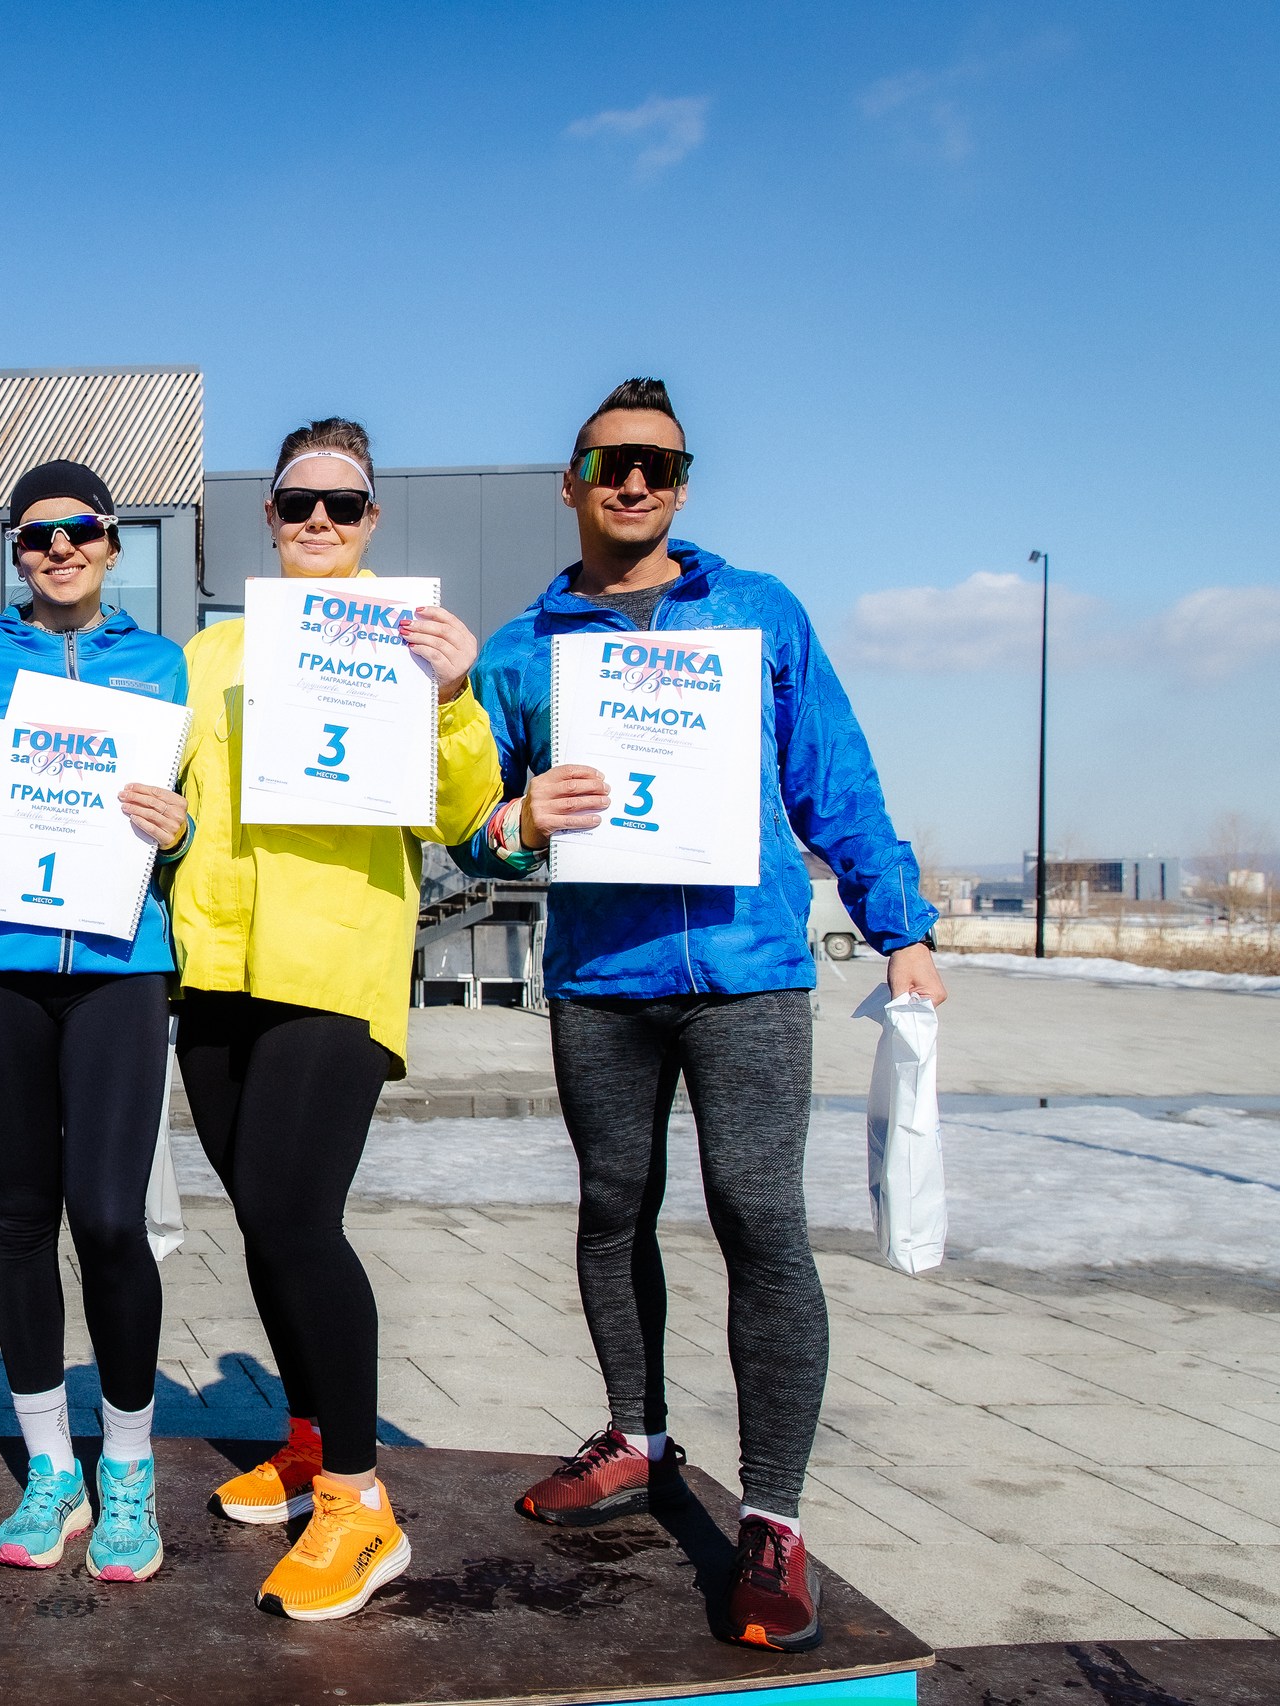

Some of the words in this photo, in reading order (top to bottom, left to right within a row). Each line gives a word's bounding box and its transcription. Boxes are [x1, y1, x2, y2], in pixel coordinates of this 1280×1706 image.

[303, 594, 414, 630] ГОНКА
[300, 621, 321, 633] за
[321, 620, 411, 648] Весно
[298, 652, 398, 685] ГРАМОТА
[601, 642, 723, 677] ГОНКА
[320, 675, 371, 689] НАГРАЖДАЕТСЯ
[599, 669, 622, 680] за
[622, 667, 721, 694] Весной
[323, 696, 367, 709] РЕЗУЛЬТАТОМ
[599, 700, 706, 730] ГРАМОТА
[623, 722, 678, 736] НАГРАЖДАЕТСЯ
[12, 728, 118, 758] ГОНКА
[317, 723, 350, 767] 3
[626, 744, 674, 756] РЕЗУЛЬТАТОМ
[10, 753, 30, 764] за
[30, 750, 116, 776] Весной
[316, 770, 338, 780] МЕСТО
[10, 783, 105, 809] ГРАМОТА
[623, 772, 656, 817] 3
[31, 804, 80, 815] НАГРАЖДАЕТСЯ
[34, 824, 76, 834] РЕЗУЛЬТАТОМ
[622, 820, 646, 830] МЕСТО
[38, 852, 56, 892] 1
[32, 896, 53, 904] МЕСТО
